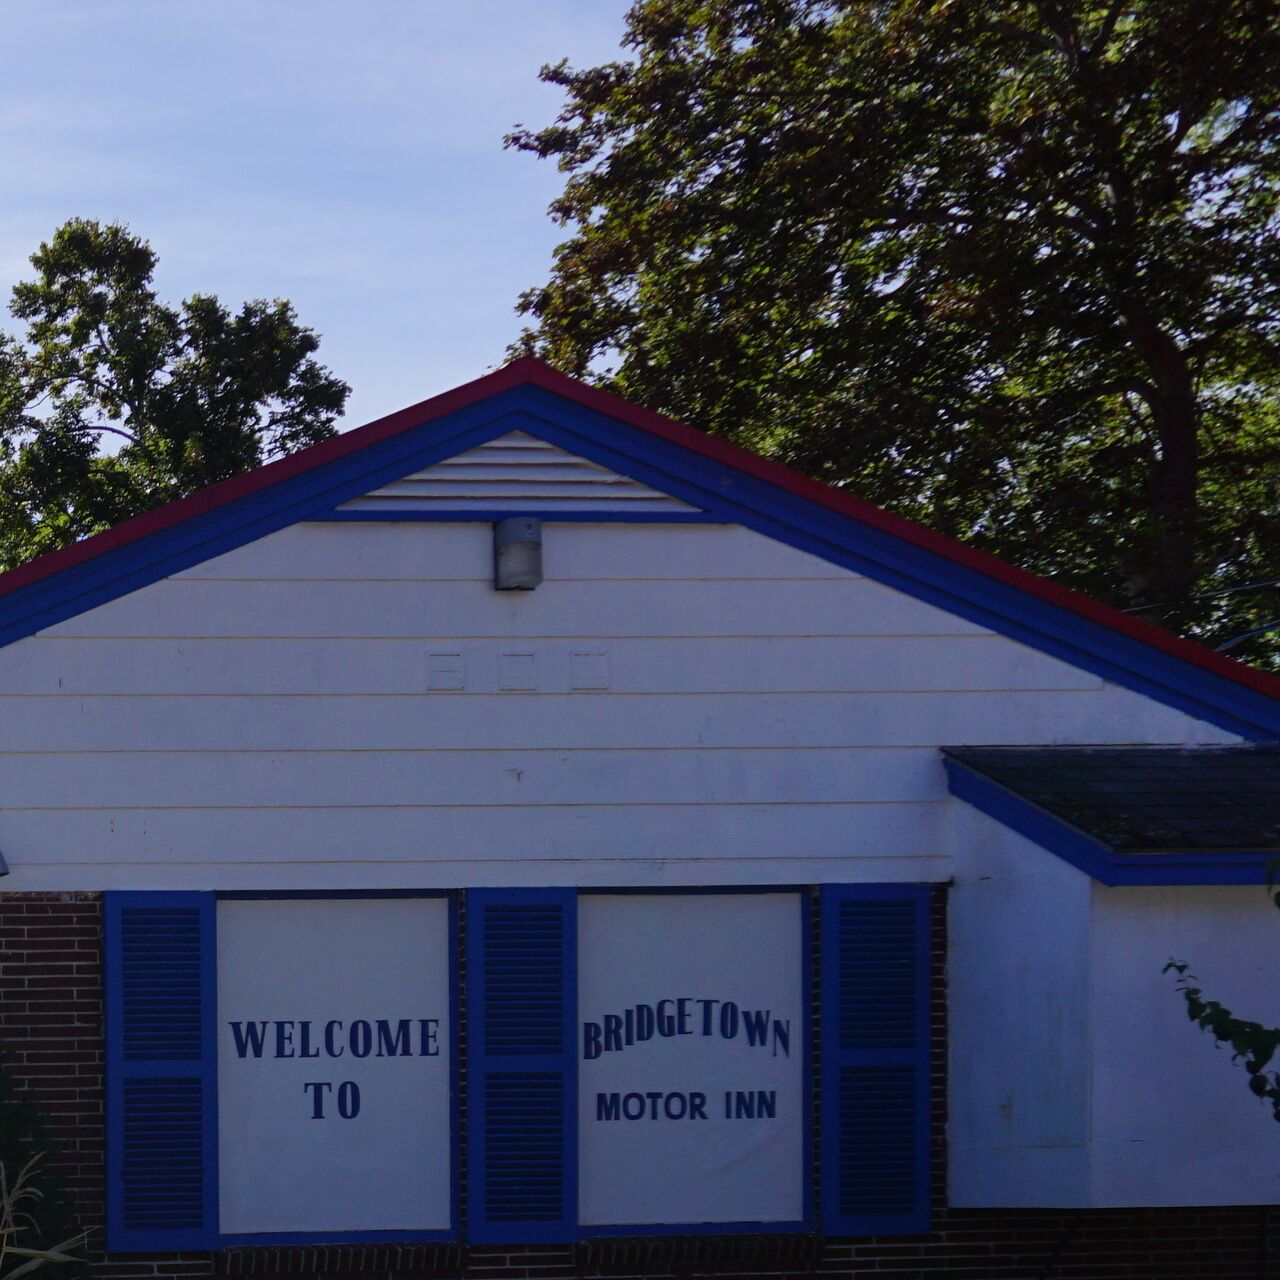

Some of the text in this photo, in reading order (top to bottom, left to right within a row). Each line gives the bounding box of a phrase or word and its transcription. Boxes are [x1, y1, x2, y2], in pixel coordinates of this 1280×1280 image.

[228, 1019, 440, 1058] WELCOME
[583, 998, 790, 1059] BRIDGETOWN
[304, 1081, 361, 1119] TO
[596, 1090, 776, 1121] MOTOR INN
